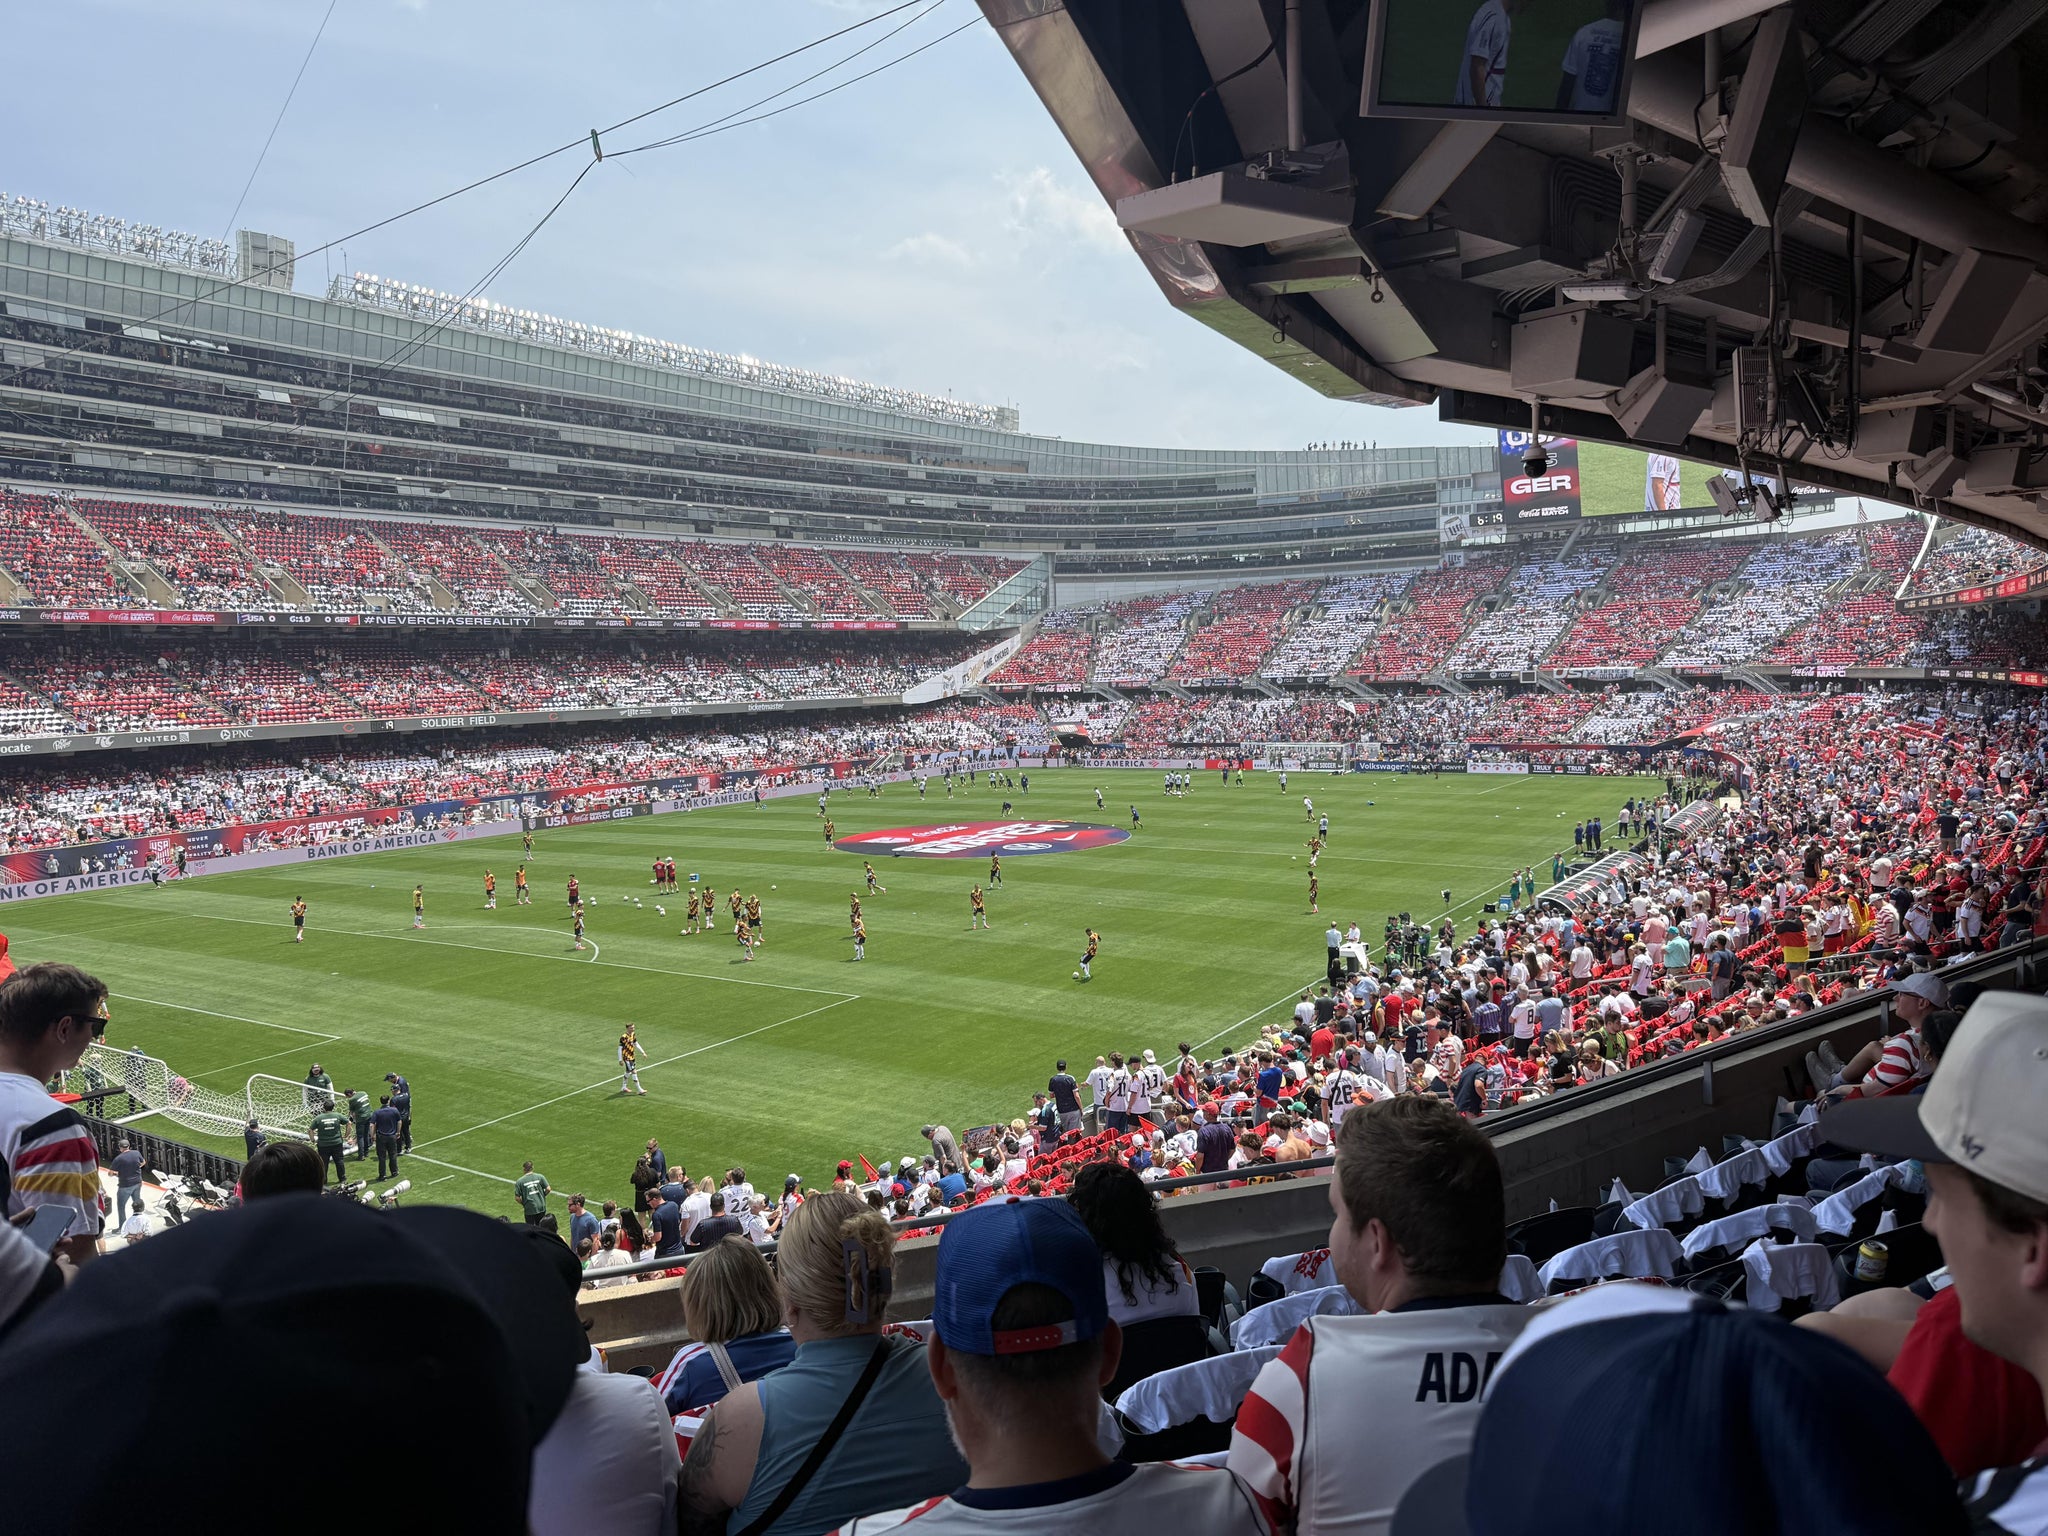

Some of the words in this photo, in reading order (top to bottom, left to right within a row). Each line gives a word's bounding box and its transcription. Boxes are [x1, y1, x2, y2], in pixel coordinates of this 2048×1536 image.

[1511, 475, 1571, 494] GER
[1518, 508, 1540, 518] Coca-Cola
[364, 616, 531, 626] #NEVERCHASEREALITY
[748, 703, 784, 711] ticketmaster
[421, 718, 464, 728] SOLDIER
[469, 715, 496, 725] FIELD
[135, 735, 177, 744] UNITED
[232, 729, 253, 739] PNC
[966, 762, 996, 771] AMERICA
[701, 796, 713, 806] OF
[715, 792, 753, 804] AMERICA
[612, 807, 633, 818] GER
[308, 817, 365, 831] SEND-OFF
[545, 815, 569, 827] USA
[308, 843, 349, 859] BANK
[352, 840, 370, 852] OF
[374, 832, 437, 850] AMERICA
[35, 880, 59, 895] OF
[65, 869, 152, 892] AMERICA
[1527, 1009, 1534, 1024] 8
[1332, 1084, 1353, 1105] 26
[730, 1197, 750, 1213] 22
